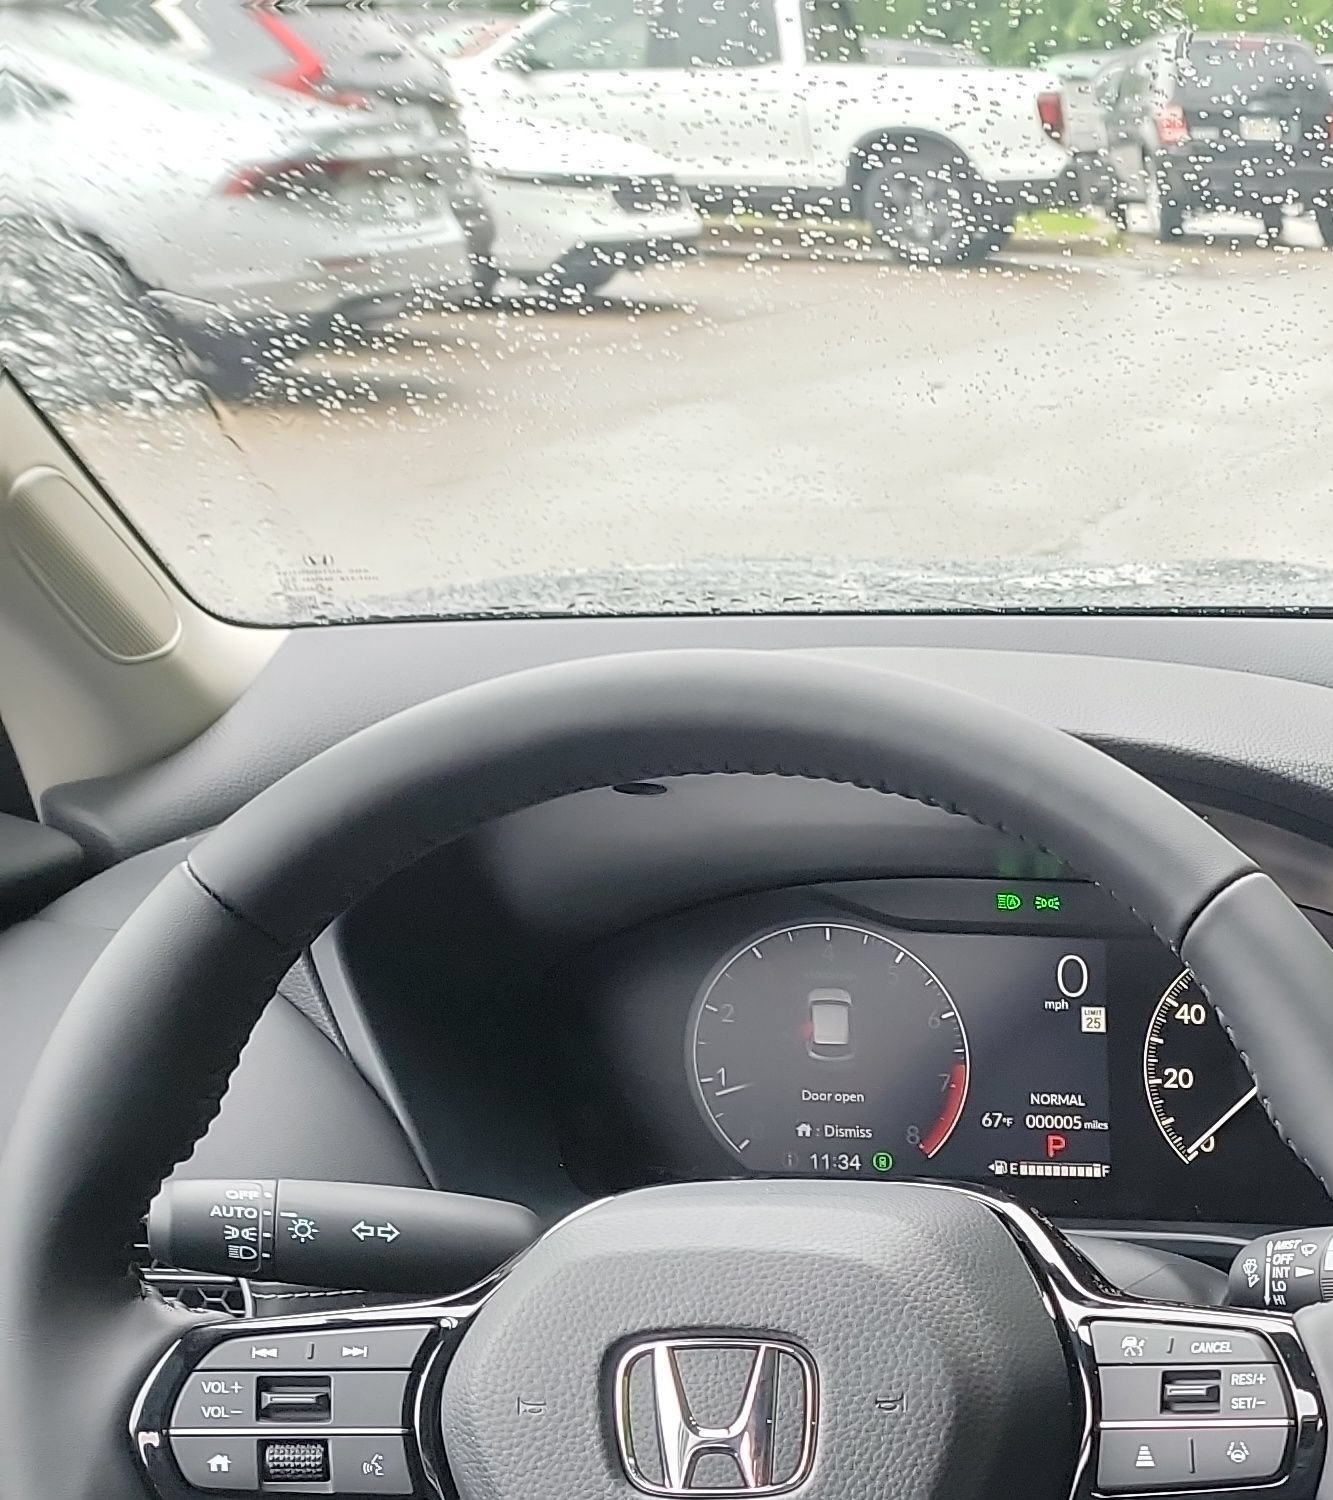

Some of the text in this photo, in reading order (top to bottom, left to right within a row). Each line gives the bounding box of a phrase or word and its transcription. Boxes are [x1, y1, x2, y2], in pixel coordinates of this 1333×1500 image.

[1056, 954, 1089, 998] 0
[721, 1003, 734, 1022] 2
[1044, 999, 1069, 1011] mph
[928, 1012, 941, 1028] 6
[1175, 1003, 1206, 1025] 40
[1085, 1017, 1102, 1029] 25
[716, 1067, 727, 1087] 1
[937, 1074, 951, 1092] 7
[1163, 1068, 1194, 1089] 20
[801, 1090, 865, 1104] Door open
[1030, 1093, 1086, 1107] NORMAL
[981, 1112, 1109, 1130] 67°F 000005 miles
[824, 1125, 873, 1139] Dismiss
[906, 1125, 920, 1145] 8
[1046, 1134, 1067, 1158] P
[810, 1153, 862, 1170] 11:34
[1010, 1162, 1019, 1176] E
[1102, 1164, 1111, 1178] F
[209, 1204, 258, 1219] AUTO
[1274, 1239, 1303, 1251] MIST
[1272, 1253, 1295, 1265] OFF
[1272, 1266, 1291, 1279] INT
[1271, 1280, 1287, 1292] LO
[1272, 1294, 1287, 1306] HI
[1190, 1341, 1233, 1355] CANCEL
[1230, 1372, 1267, 1387] RES/+
[201, 1380, 244, 1395] VOL+
